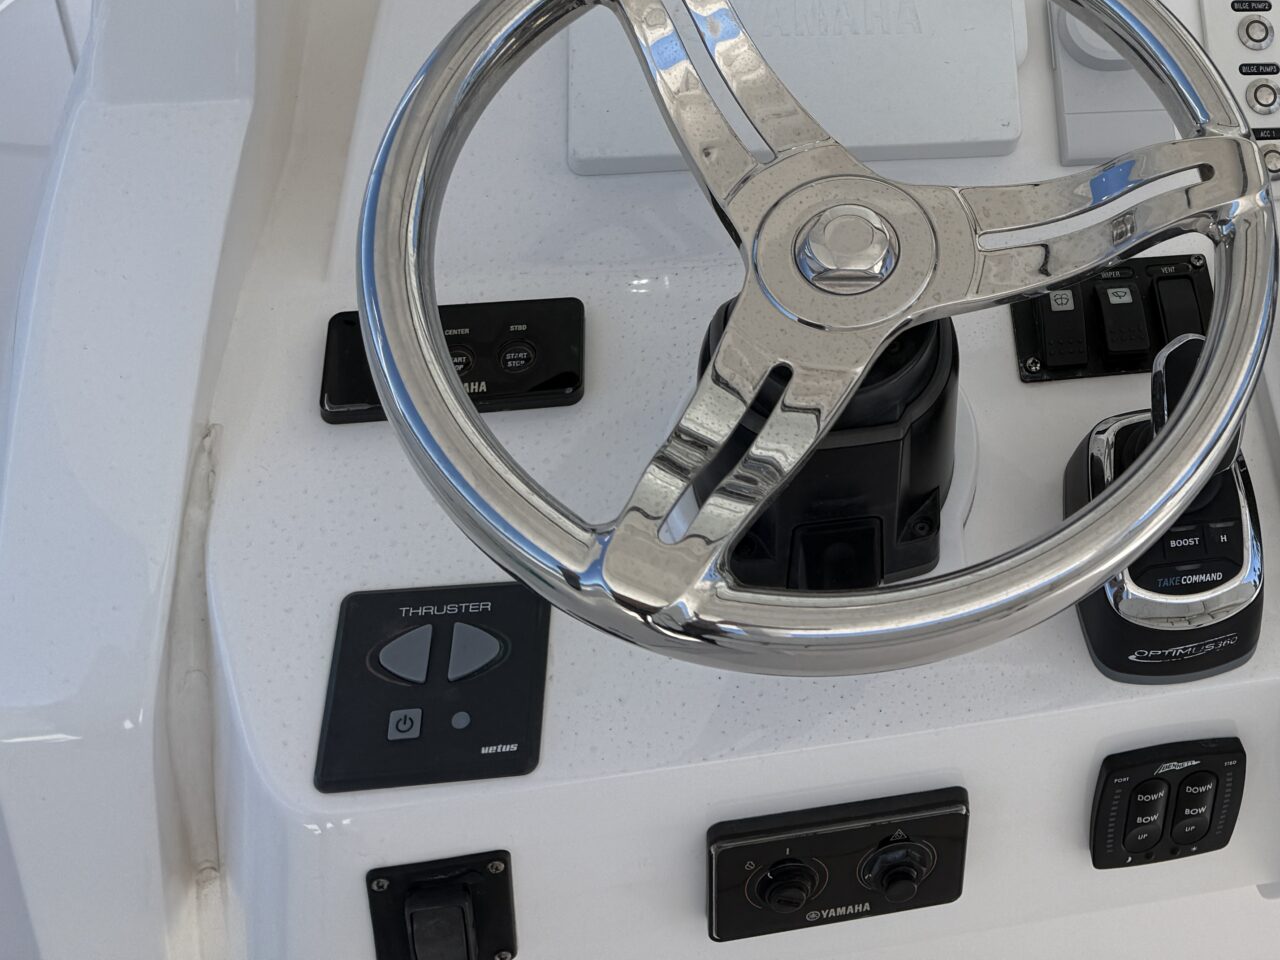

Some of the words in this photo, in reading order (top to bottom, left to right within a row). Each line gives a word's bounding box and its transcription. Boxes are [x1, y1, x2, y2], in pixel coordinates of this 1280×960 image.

[1234, 2, 1249, 10] BILGE
[1101, 270, 1121, 279] WIPER
[1160, 266, 1175, 274] VENT
[444, 328, 470, 336] CENTER
[509, 324, 527, 332] STBD
[505, 352, 528, 360] START
[1170, 537, 1200, 548] BOOST
[1220, 534, 1227, 543] H
[399, 602, 492, 617] THRUSTER
[481, 743, 518, 755] vetus
[1114, 776, 1130, 784] PORT
[1186, 782, 1213, 794] DOWN
[1137, 790, 1165, 802] DOWN
[1184, 806, 1207, 815] BOW
[1136, 813, 1159, 824] BOW
[820, 902, 871, 919] YAMAHA
